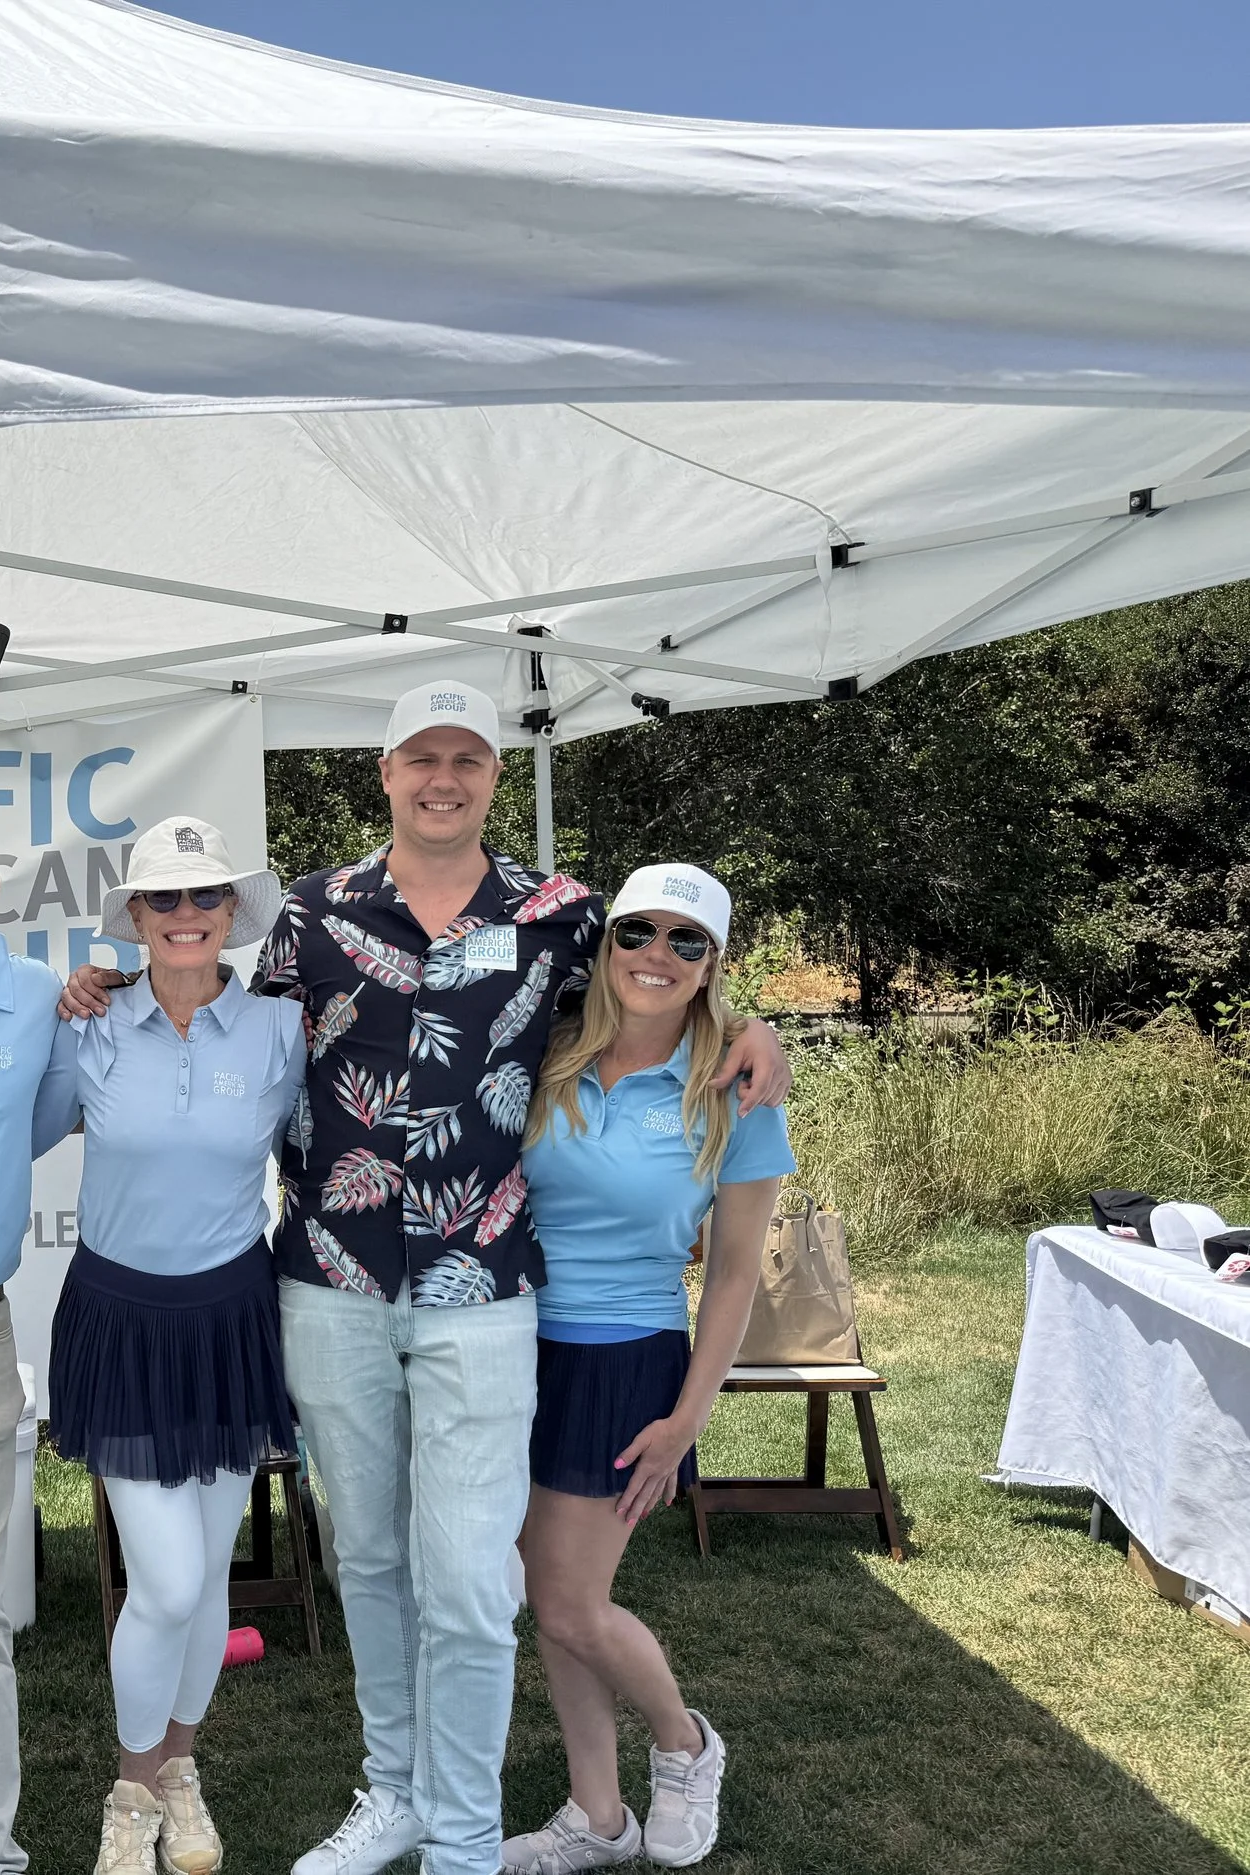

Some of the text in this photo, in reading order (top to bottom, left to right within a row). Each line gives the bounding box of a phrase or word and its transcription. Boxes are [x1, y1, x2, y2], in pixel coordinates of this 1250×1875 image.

[431, 693, 466, 701] PACIFIC
[431, 704, 466, 712] GROUP
[664, 877, 701, 893] PACIFIC
[662, 888, 698, 903] GROUP
[468, 938, 515, 948] AMERICAN
[467, 946, 515, 959] GROUP
[214, 1071, 245, 1083] PACIFIC
[214, 1085, 245, 1096] GROUP
[647, 1107, 682, 1122] PACIFIC
[642, 1120, 679, 1135] GROUP
